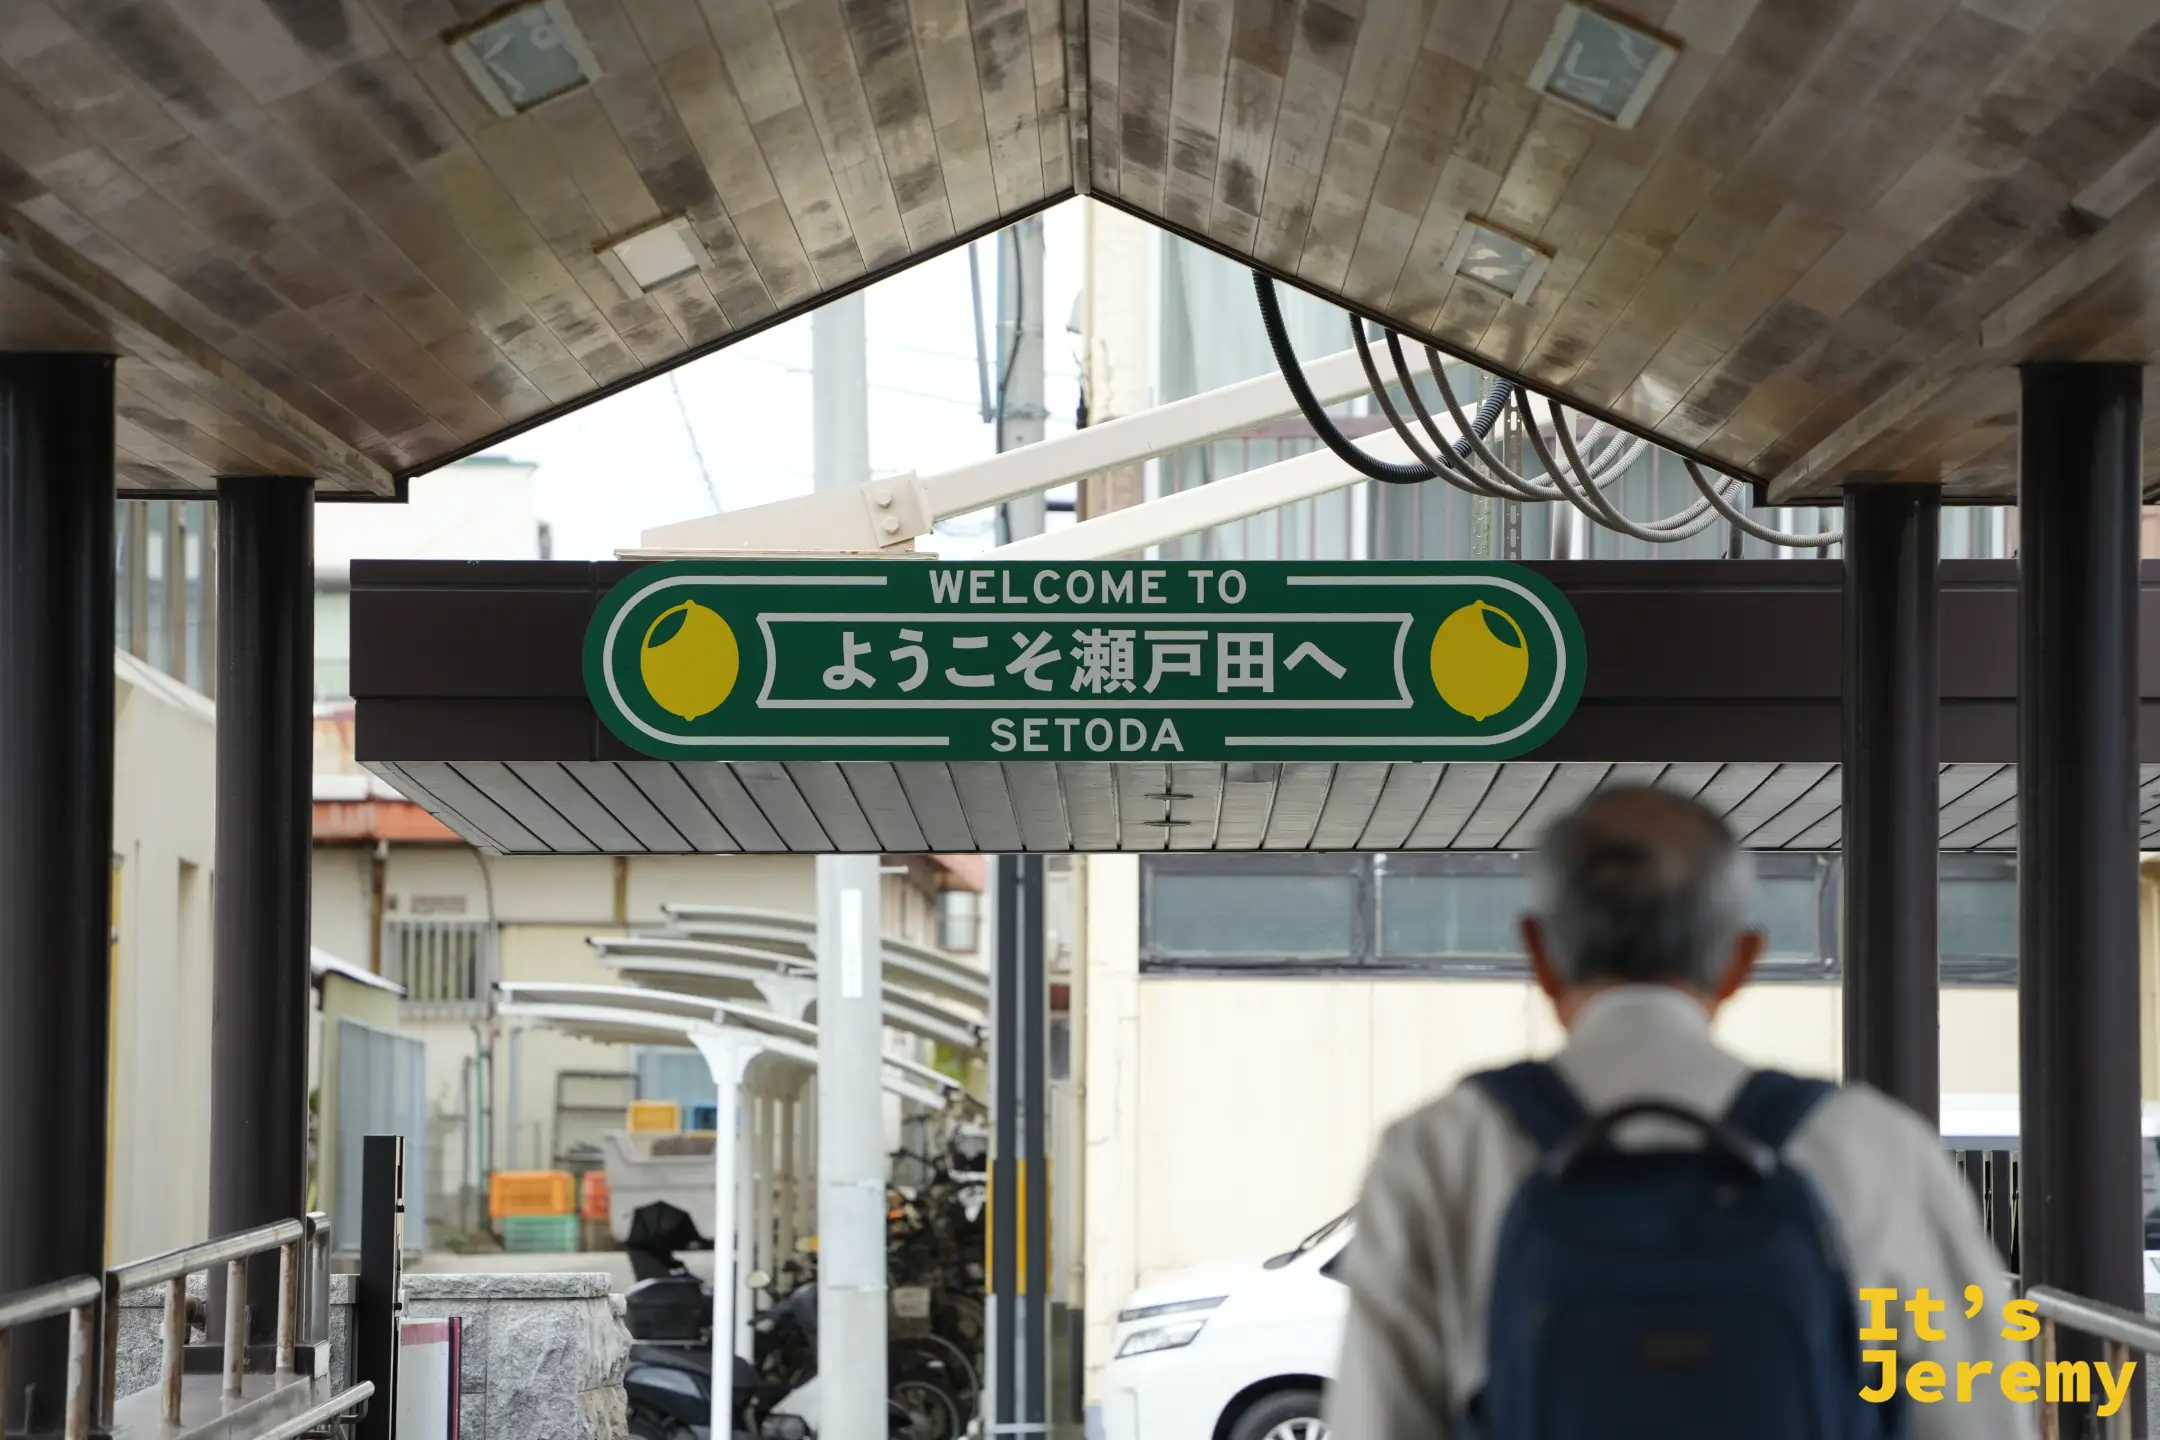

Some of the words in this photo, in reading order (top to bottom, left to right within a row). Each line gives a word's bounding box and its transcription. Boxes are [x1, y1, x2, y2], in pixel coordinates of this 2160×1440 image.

[930, 569, 1168, 604] WELCOME
[1189, 569, 1247, 604] TO
[822, 628, 1347, 694] ようこそ瀬戸田へ
[991, 717, 1184, 752] SETODA
